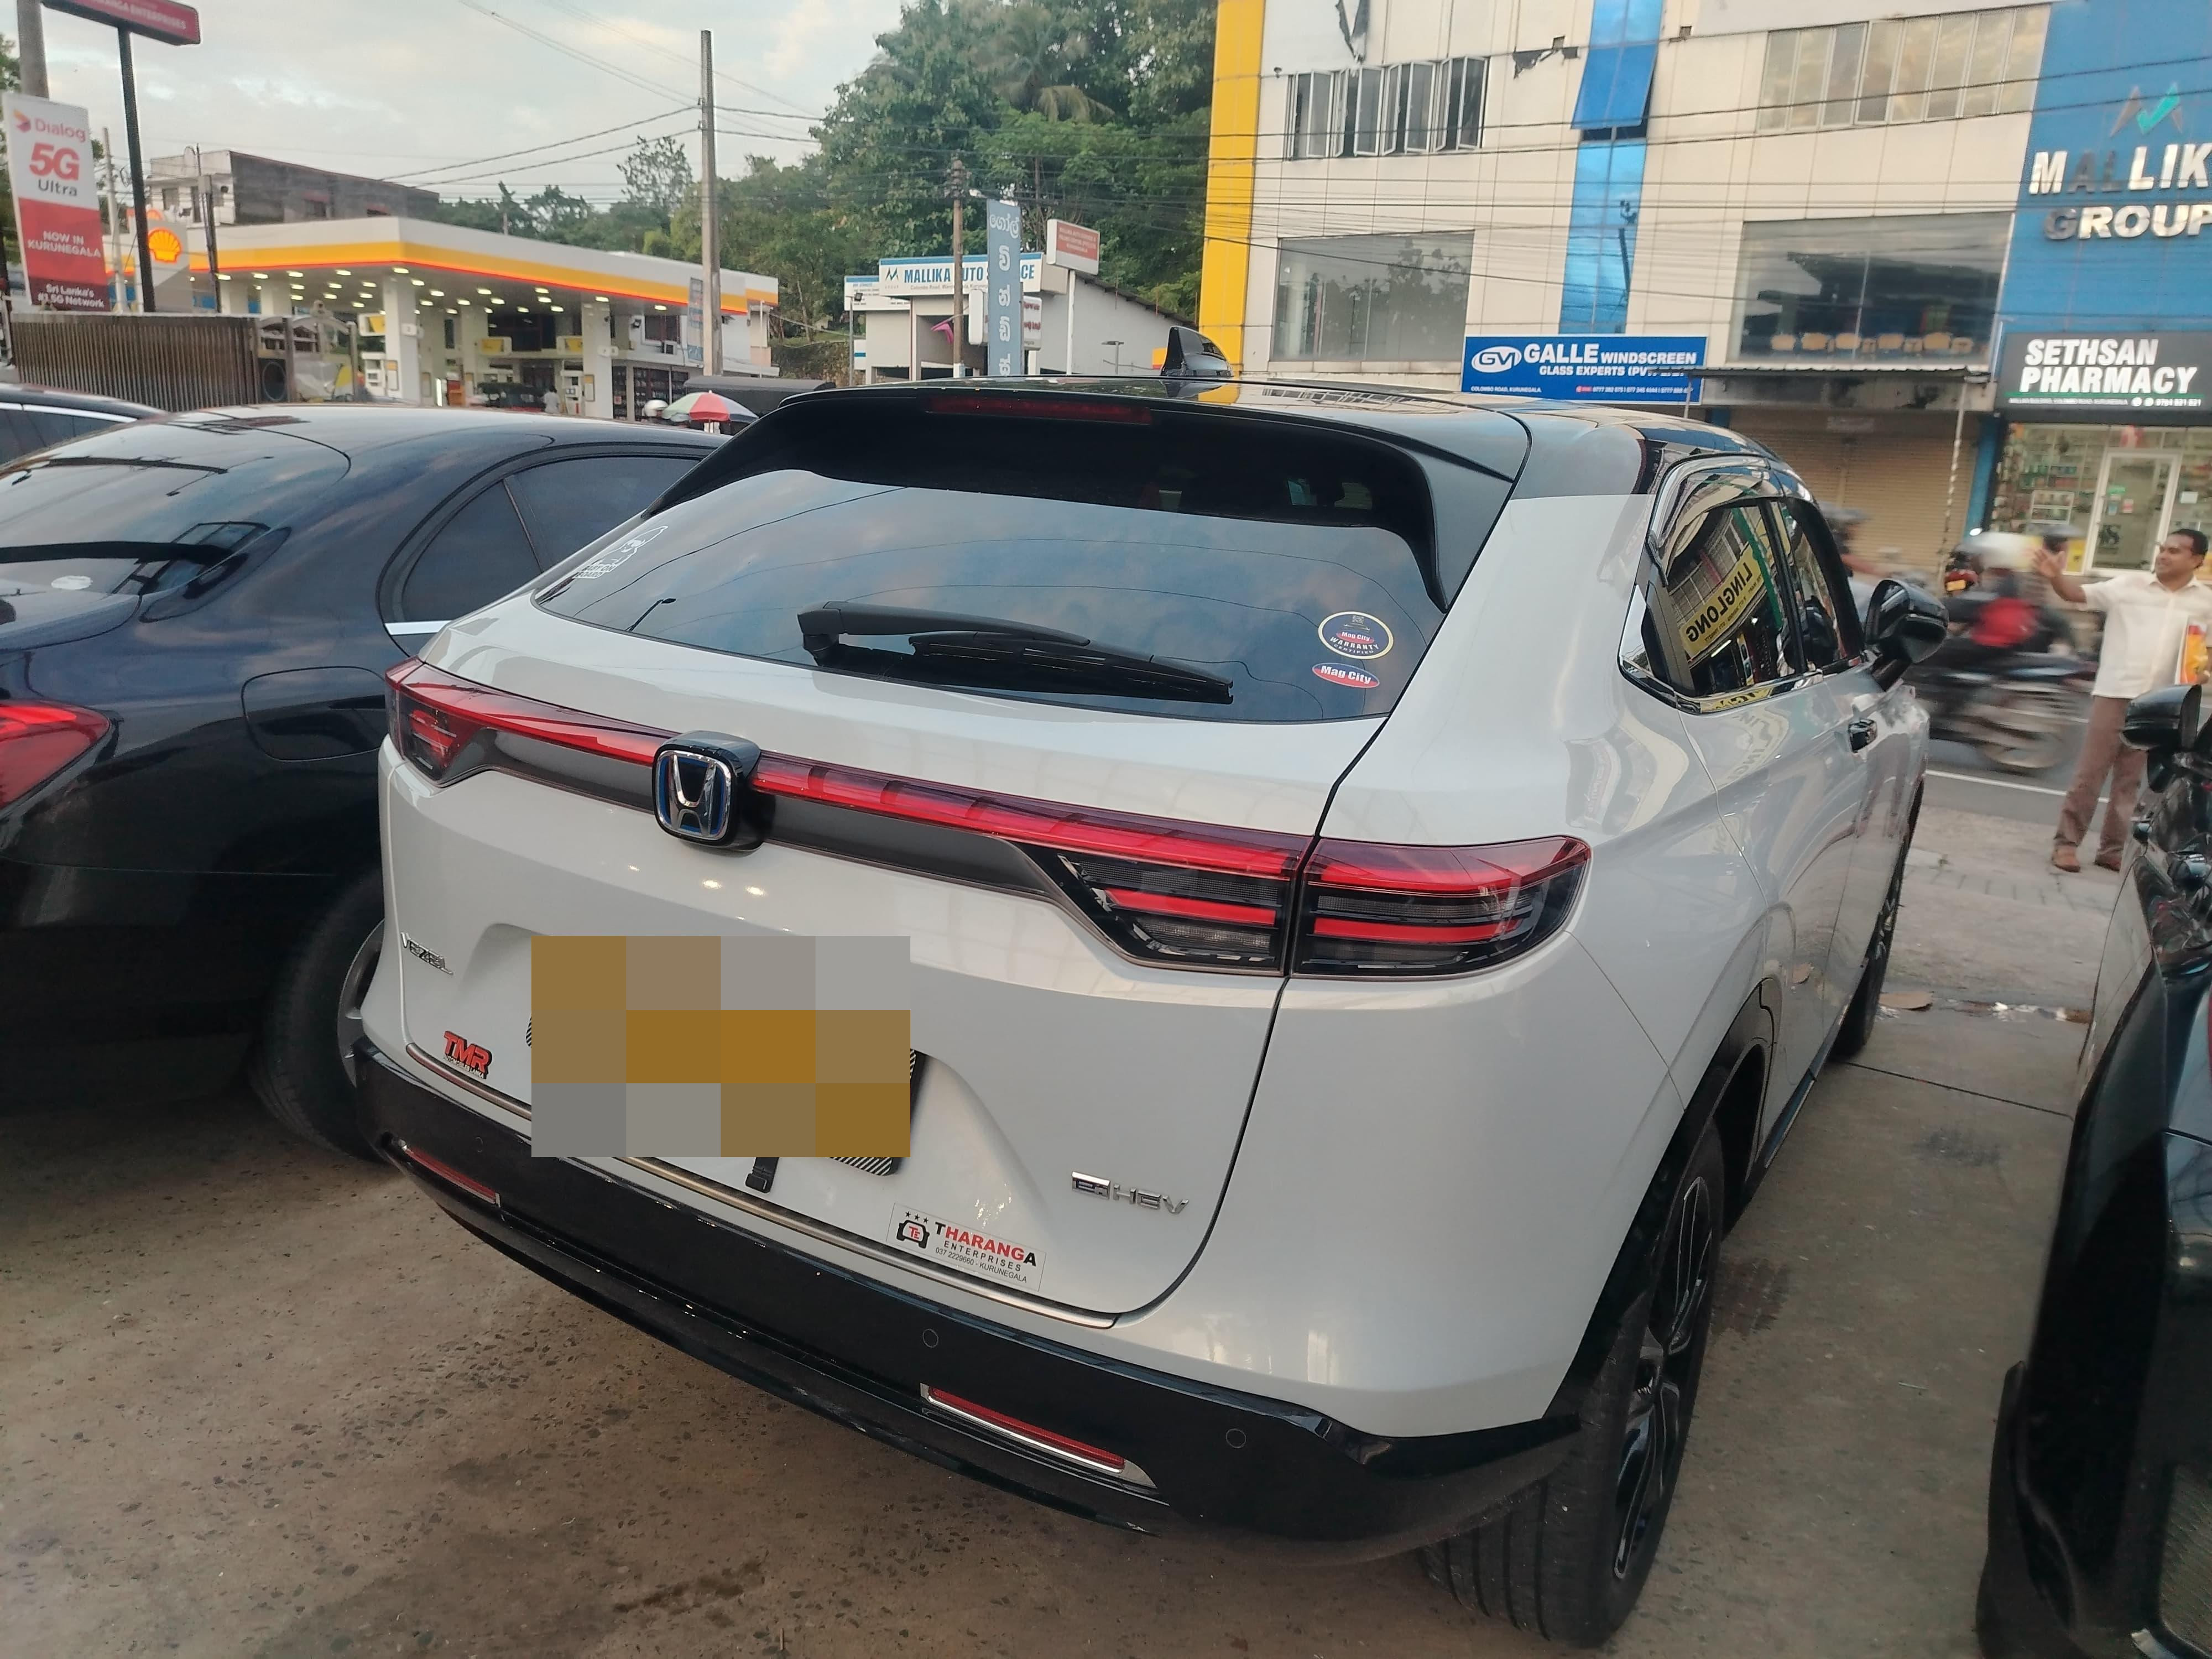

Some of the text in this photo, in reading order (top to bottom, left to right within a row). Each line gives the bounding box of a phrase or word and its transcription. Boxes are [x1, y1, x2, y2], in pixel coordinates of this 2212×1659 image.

[35, 118, 86, 143] Dialog
[29, 143, 80, 181] 5G
[2029, 142, 2212, 195] MALLIK
[38, 179, 77, 196] Ultra
[2044, 204, 2212, 241] GROUP
[43, 231, 84, 245] NOW IN
[27, 239, 101, 258] KURUNEGALA
[904, 268, 951, 283] MALLIKA
[961, 267, 983, 281] UTO
[46, 284, 95, 298] Sri Lanka's
[66, 295, 104, 308] Network
[1524, 343, 1697, 364] GALLE WINDSCREEN
[2025, 338, 2159, 366] SETHSAN
[1539, 365, 1574, 375] GLASS
[1576, 366, 1625, 376] EXPERTS
[2019, 366, 2198, 394] PHARMACY
[1329, 637, 1379, 650] WARRANTY
[1357, 633, 1371, 641] City
[1333, 644, 1374, 654] CERTIFIED
[1321, 665, 1372, 685] Mag City
[444, 1030, 493, 1075] TMR
[909, 1225, 921, 1239] TE
[935, 1221, 1037, 1267] THARANGA
[935, 1246, 947, 1255] 037
[979, 1261, 1027, 1284] KURUNEGALA
[943, 1240, 1021, 1272] ENTERPRISES
